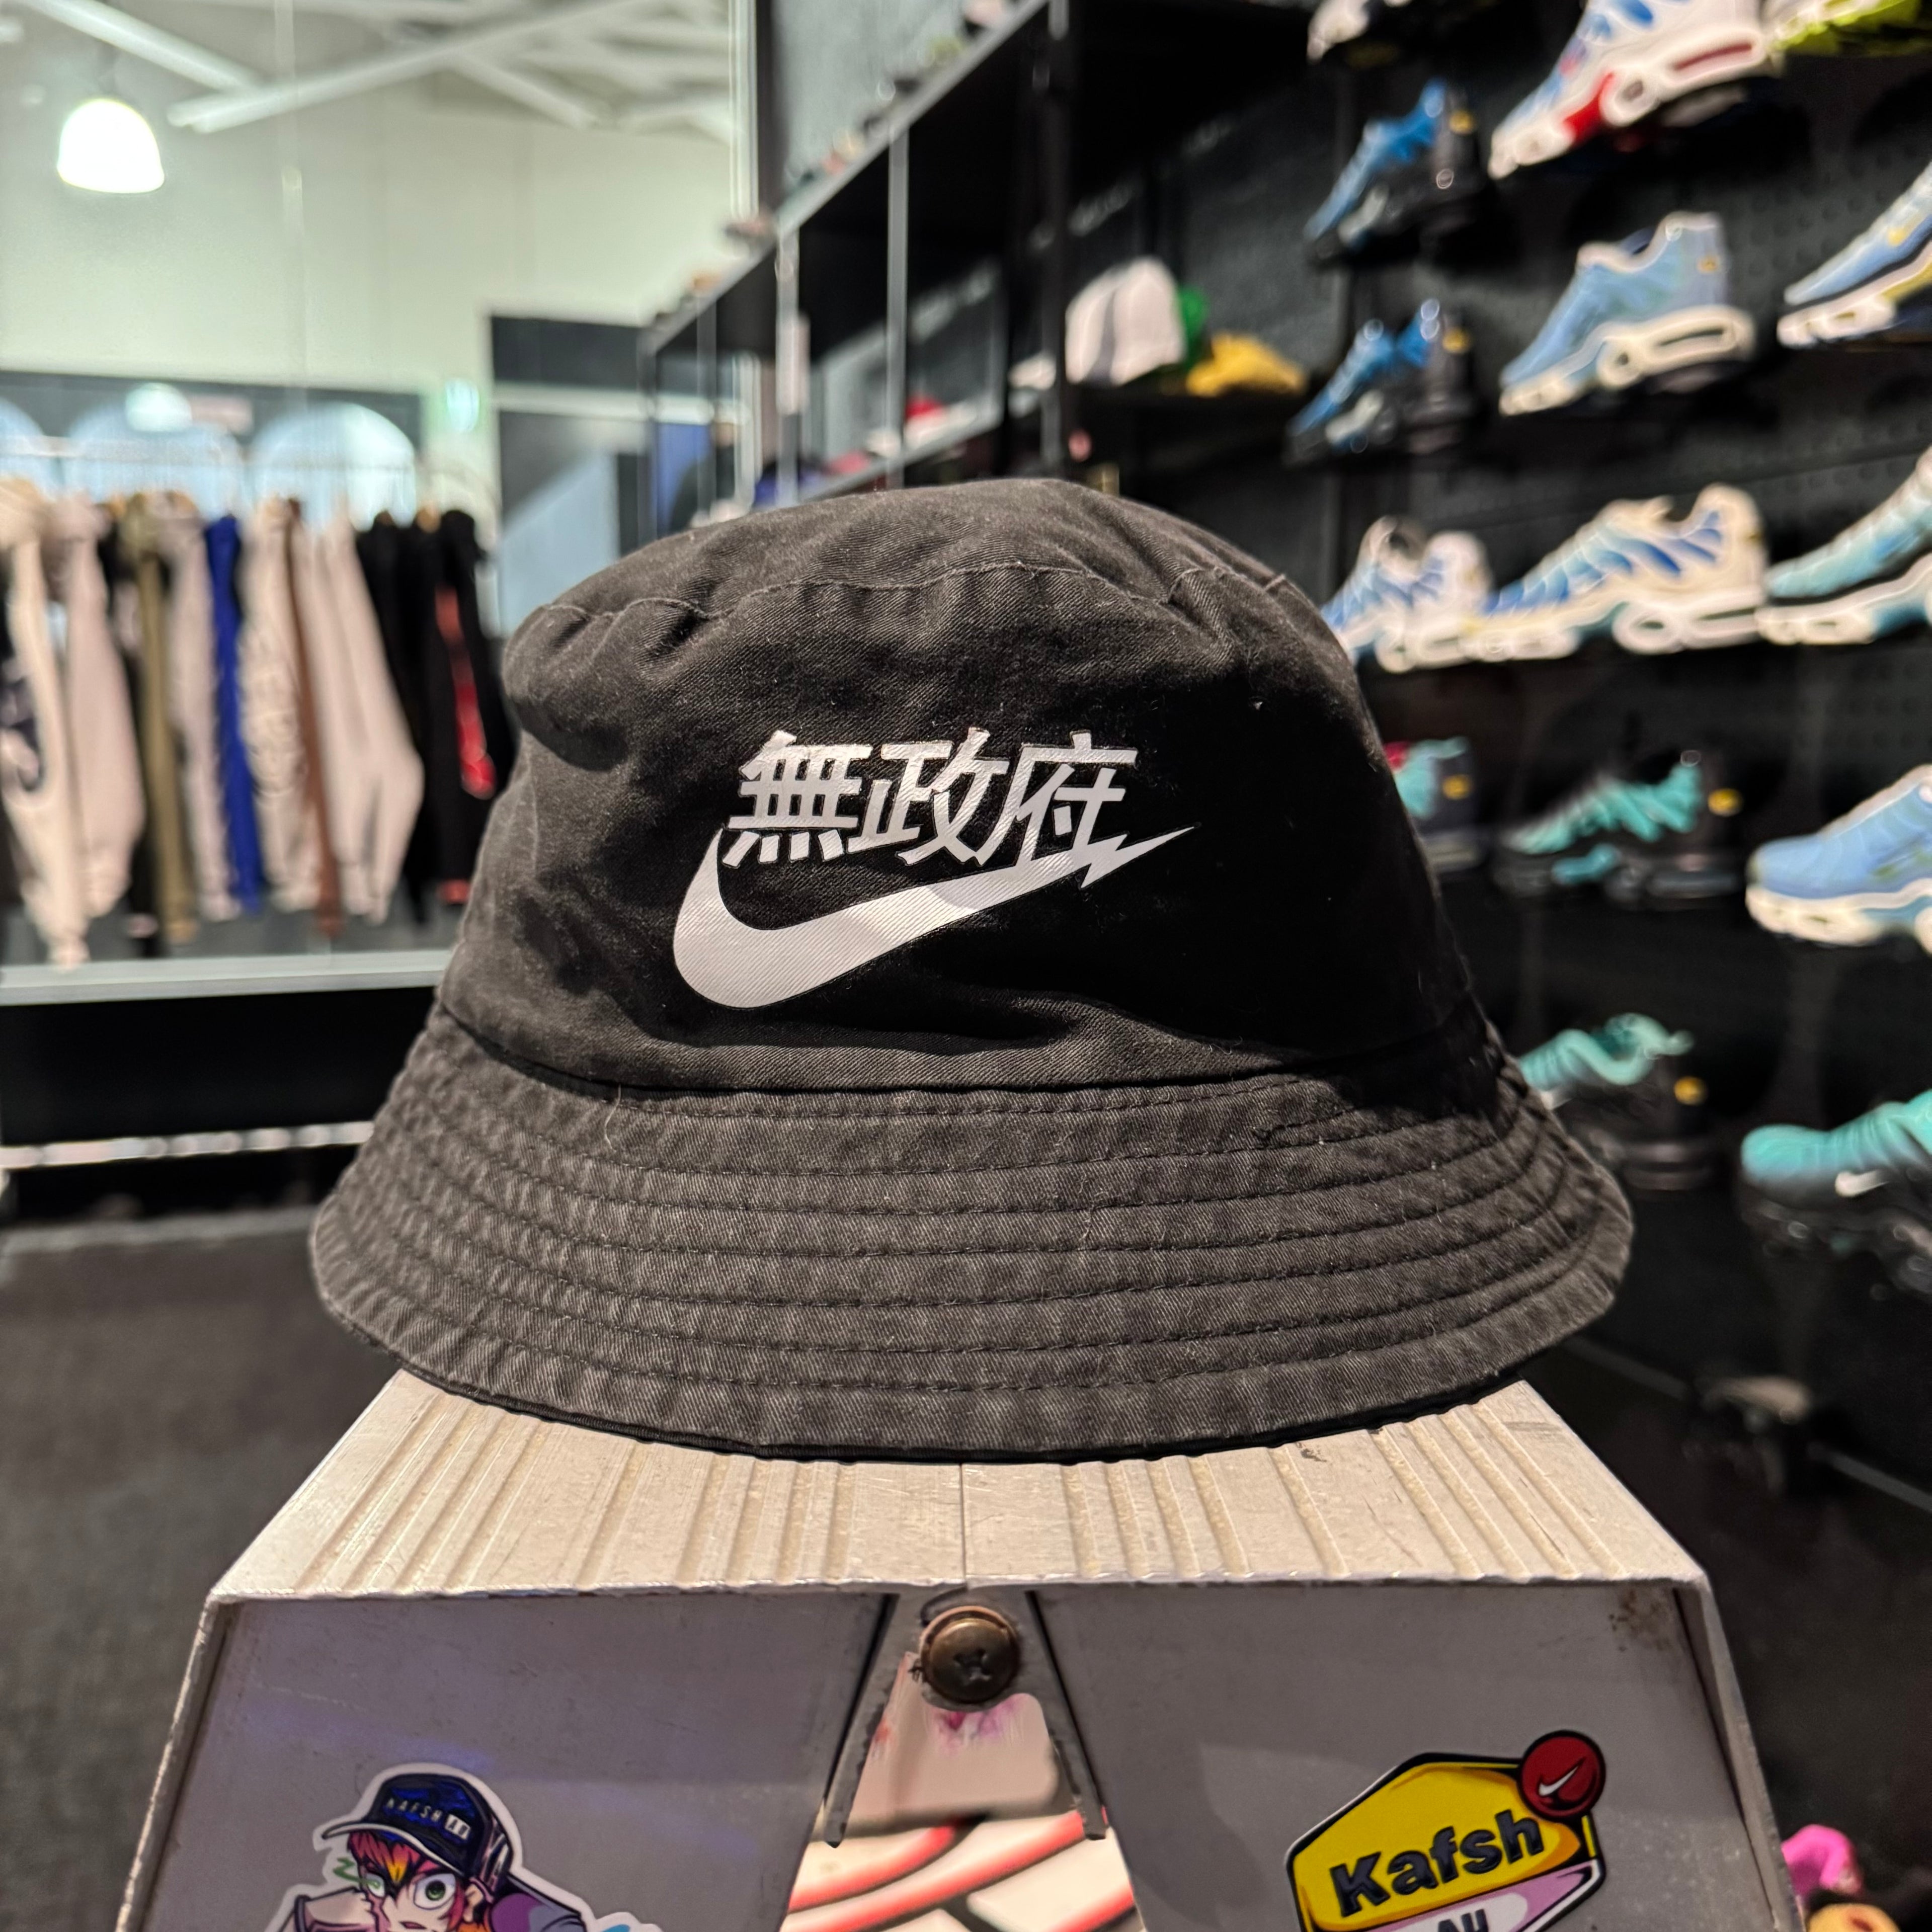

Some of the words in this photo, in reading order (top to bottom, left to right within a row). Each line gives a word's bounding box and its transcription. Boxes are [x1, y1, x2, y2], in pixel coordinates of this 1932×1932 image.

[722, 728, 1138, 868] 無政府
[1330, 1809, 1545, 1917] Kafsh
